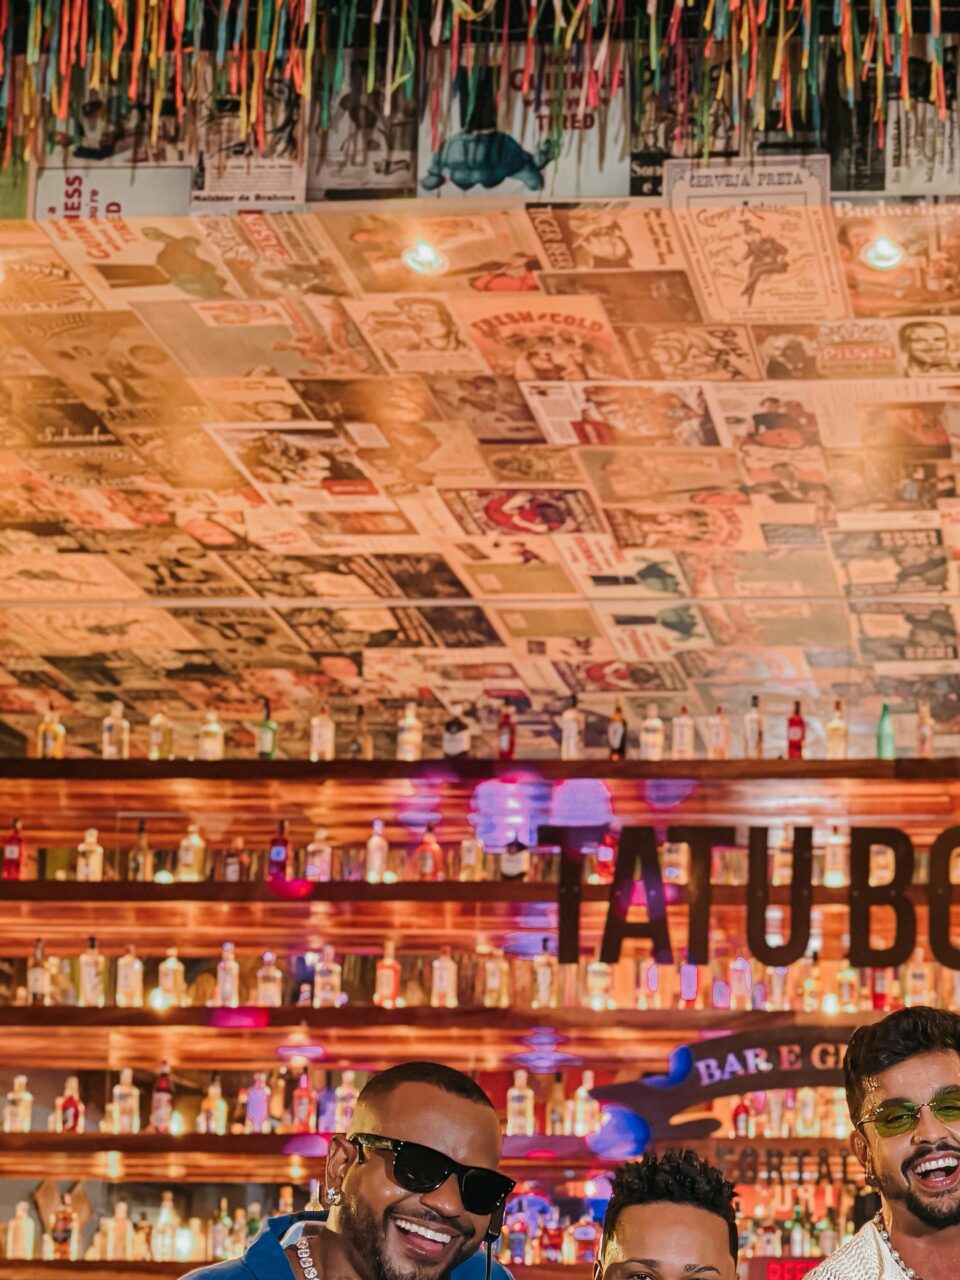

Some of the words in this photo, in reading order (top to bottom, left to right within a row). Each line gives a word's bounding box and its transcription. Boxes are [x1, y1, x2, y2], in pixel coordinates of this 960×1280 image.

[757, 172, 803, 187] PRETA
[537, 826, 814, 967] TATU
[695, 1046, 774, 1087] BAR
[778, 1044, 803, 1071] E
